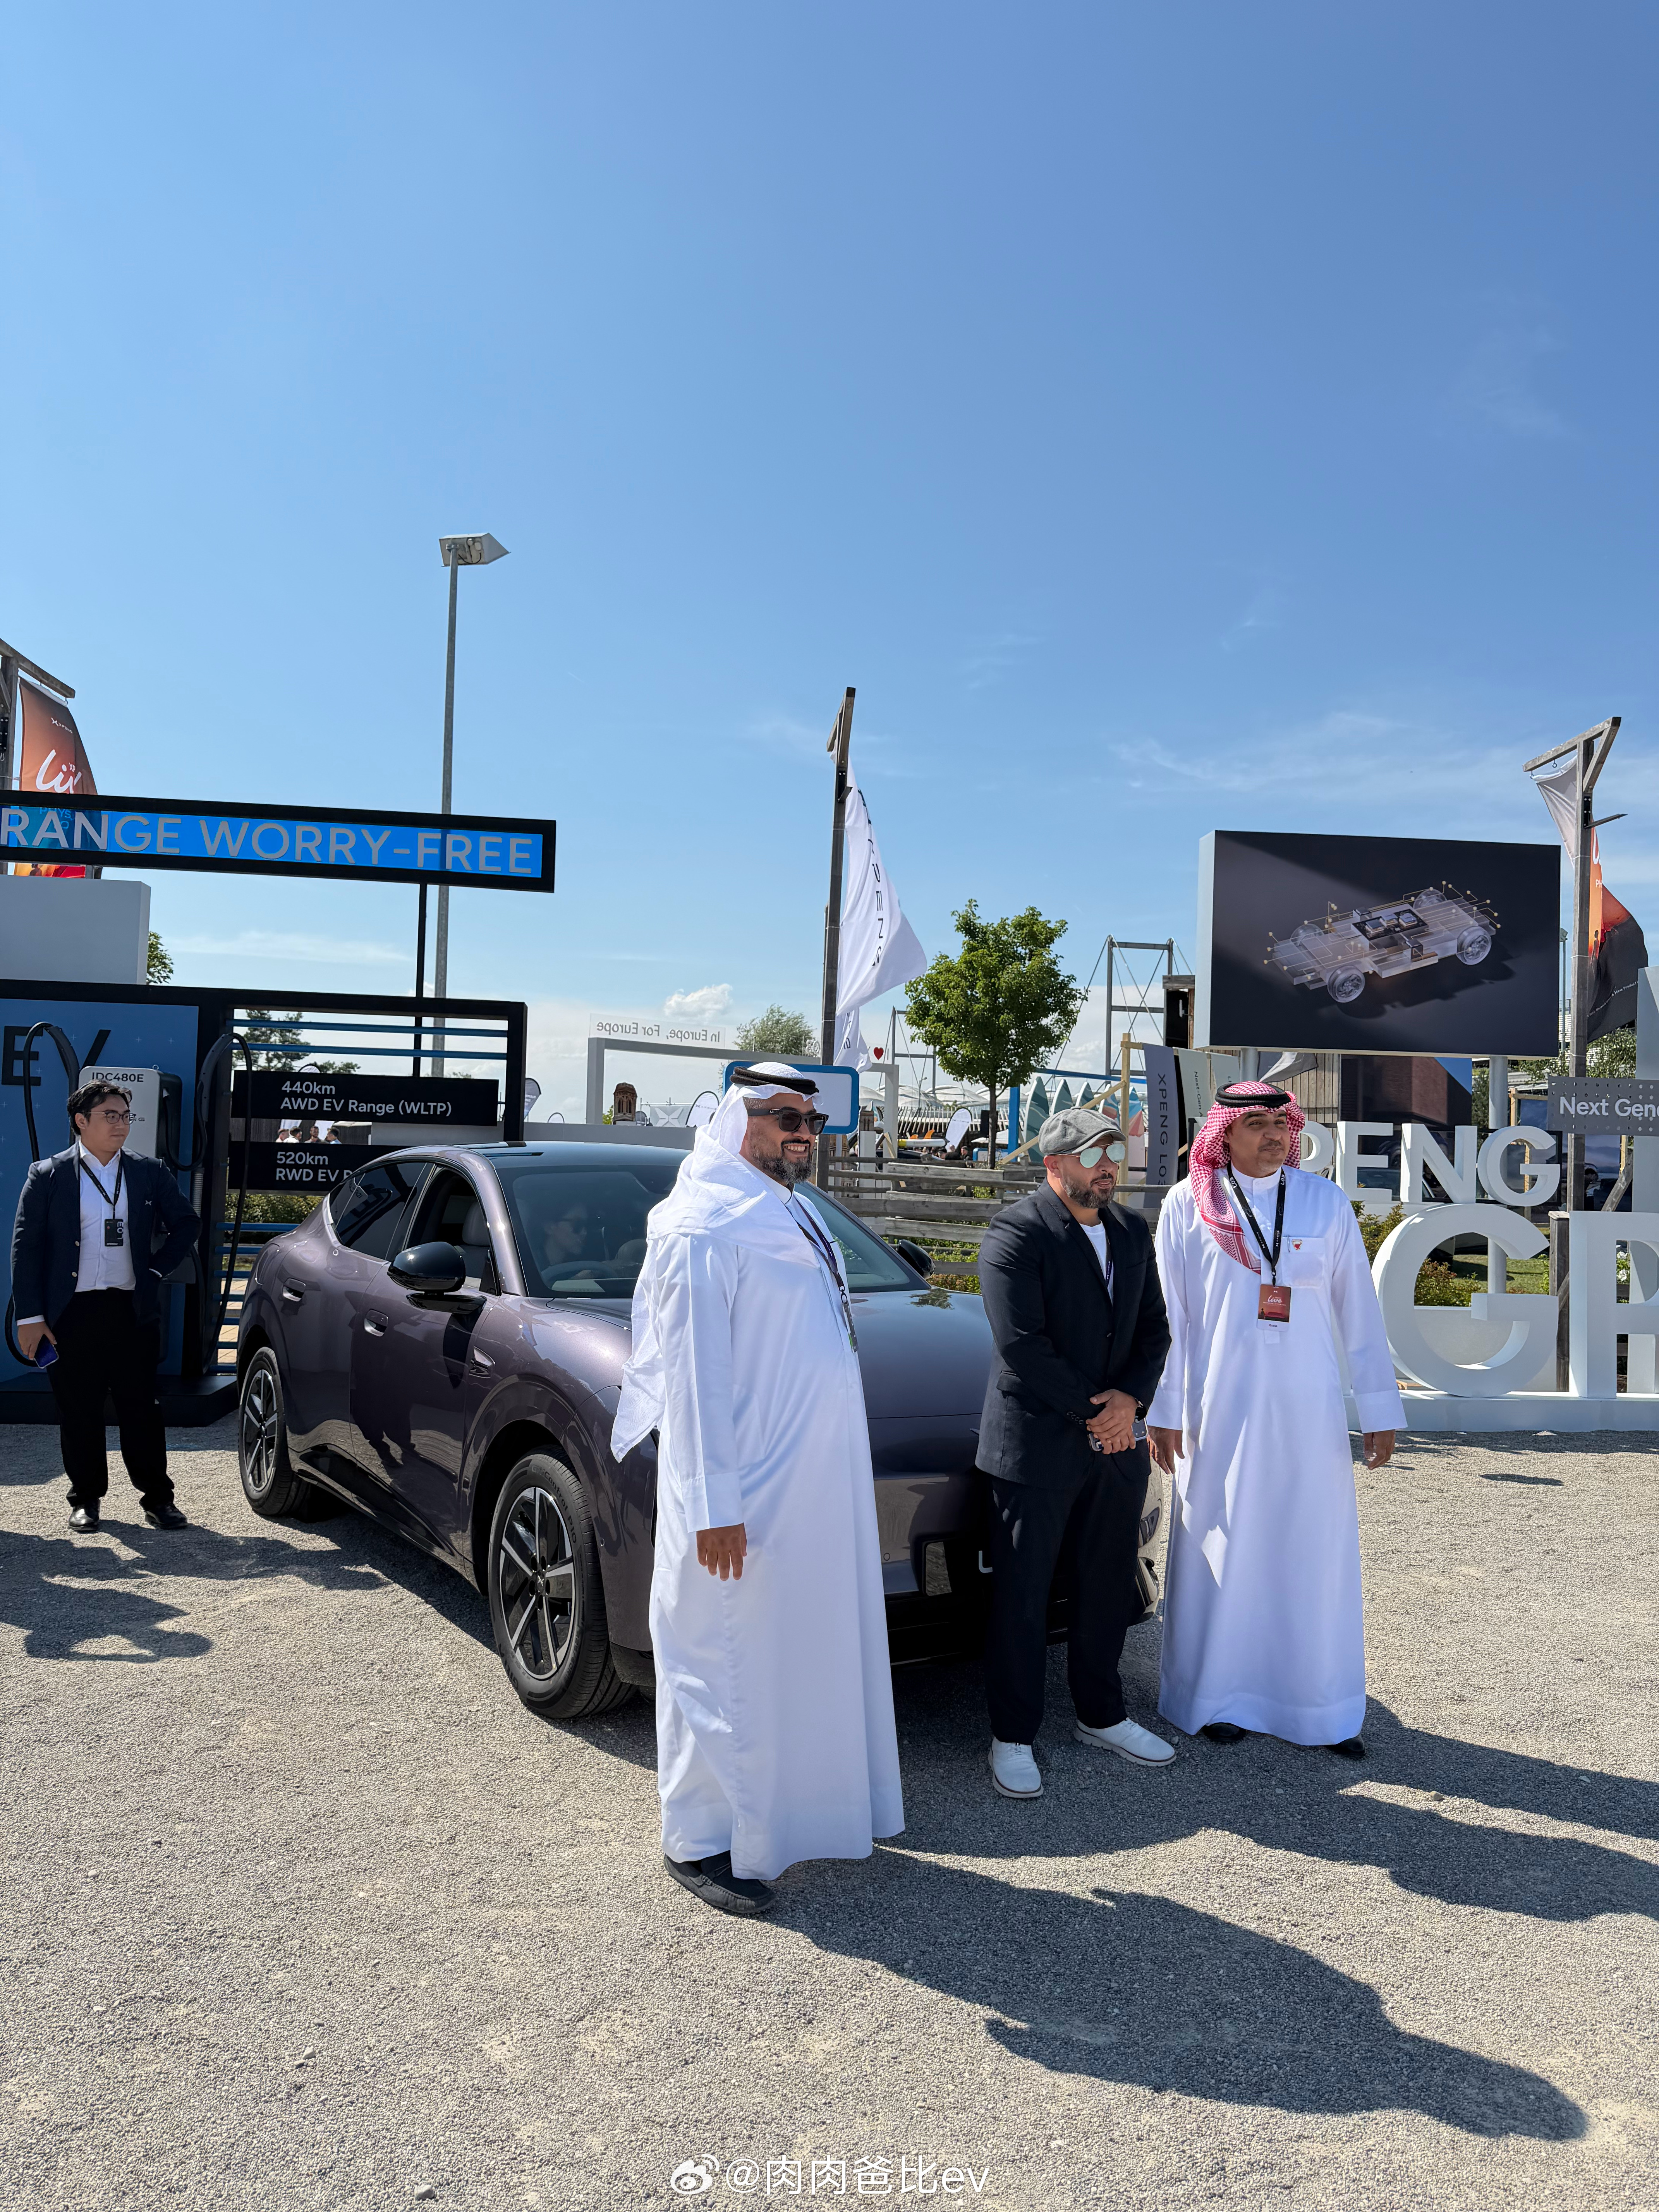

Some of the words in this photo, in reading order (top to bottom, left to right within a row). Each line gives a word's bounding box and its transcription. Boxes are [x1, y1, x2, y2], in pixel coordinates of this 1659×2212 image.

[0, 807, 182, 854] RANGE
[199, 819, 532, 874] WORRY-FREE
[92, 1072, 144, 1082] IDC480E
[282, 1080, 335, 1095] 440km
[280, 1097, 319, 1111] AWD
[323, 1099, 344, 1112] EV
[348, 1099, 395, 1116] Range
[398, 1100, 452, 1117] (WLTP)
[1158, 1073, 1168, 1146] XPENG
[1559, 1096, 1609, 1116] Next
[276, 1151, 328, 1165] 520km
[275, 1168, 313, 1182] RWD
[318, 1169, 339, 1182] EV
